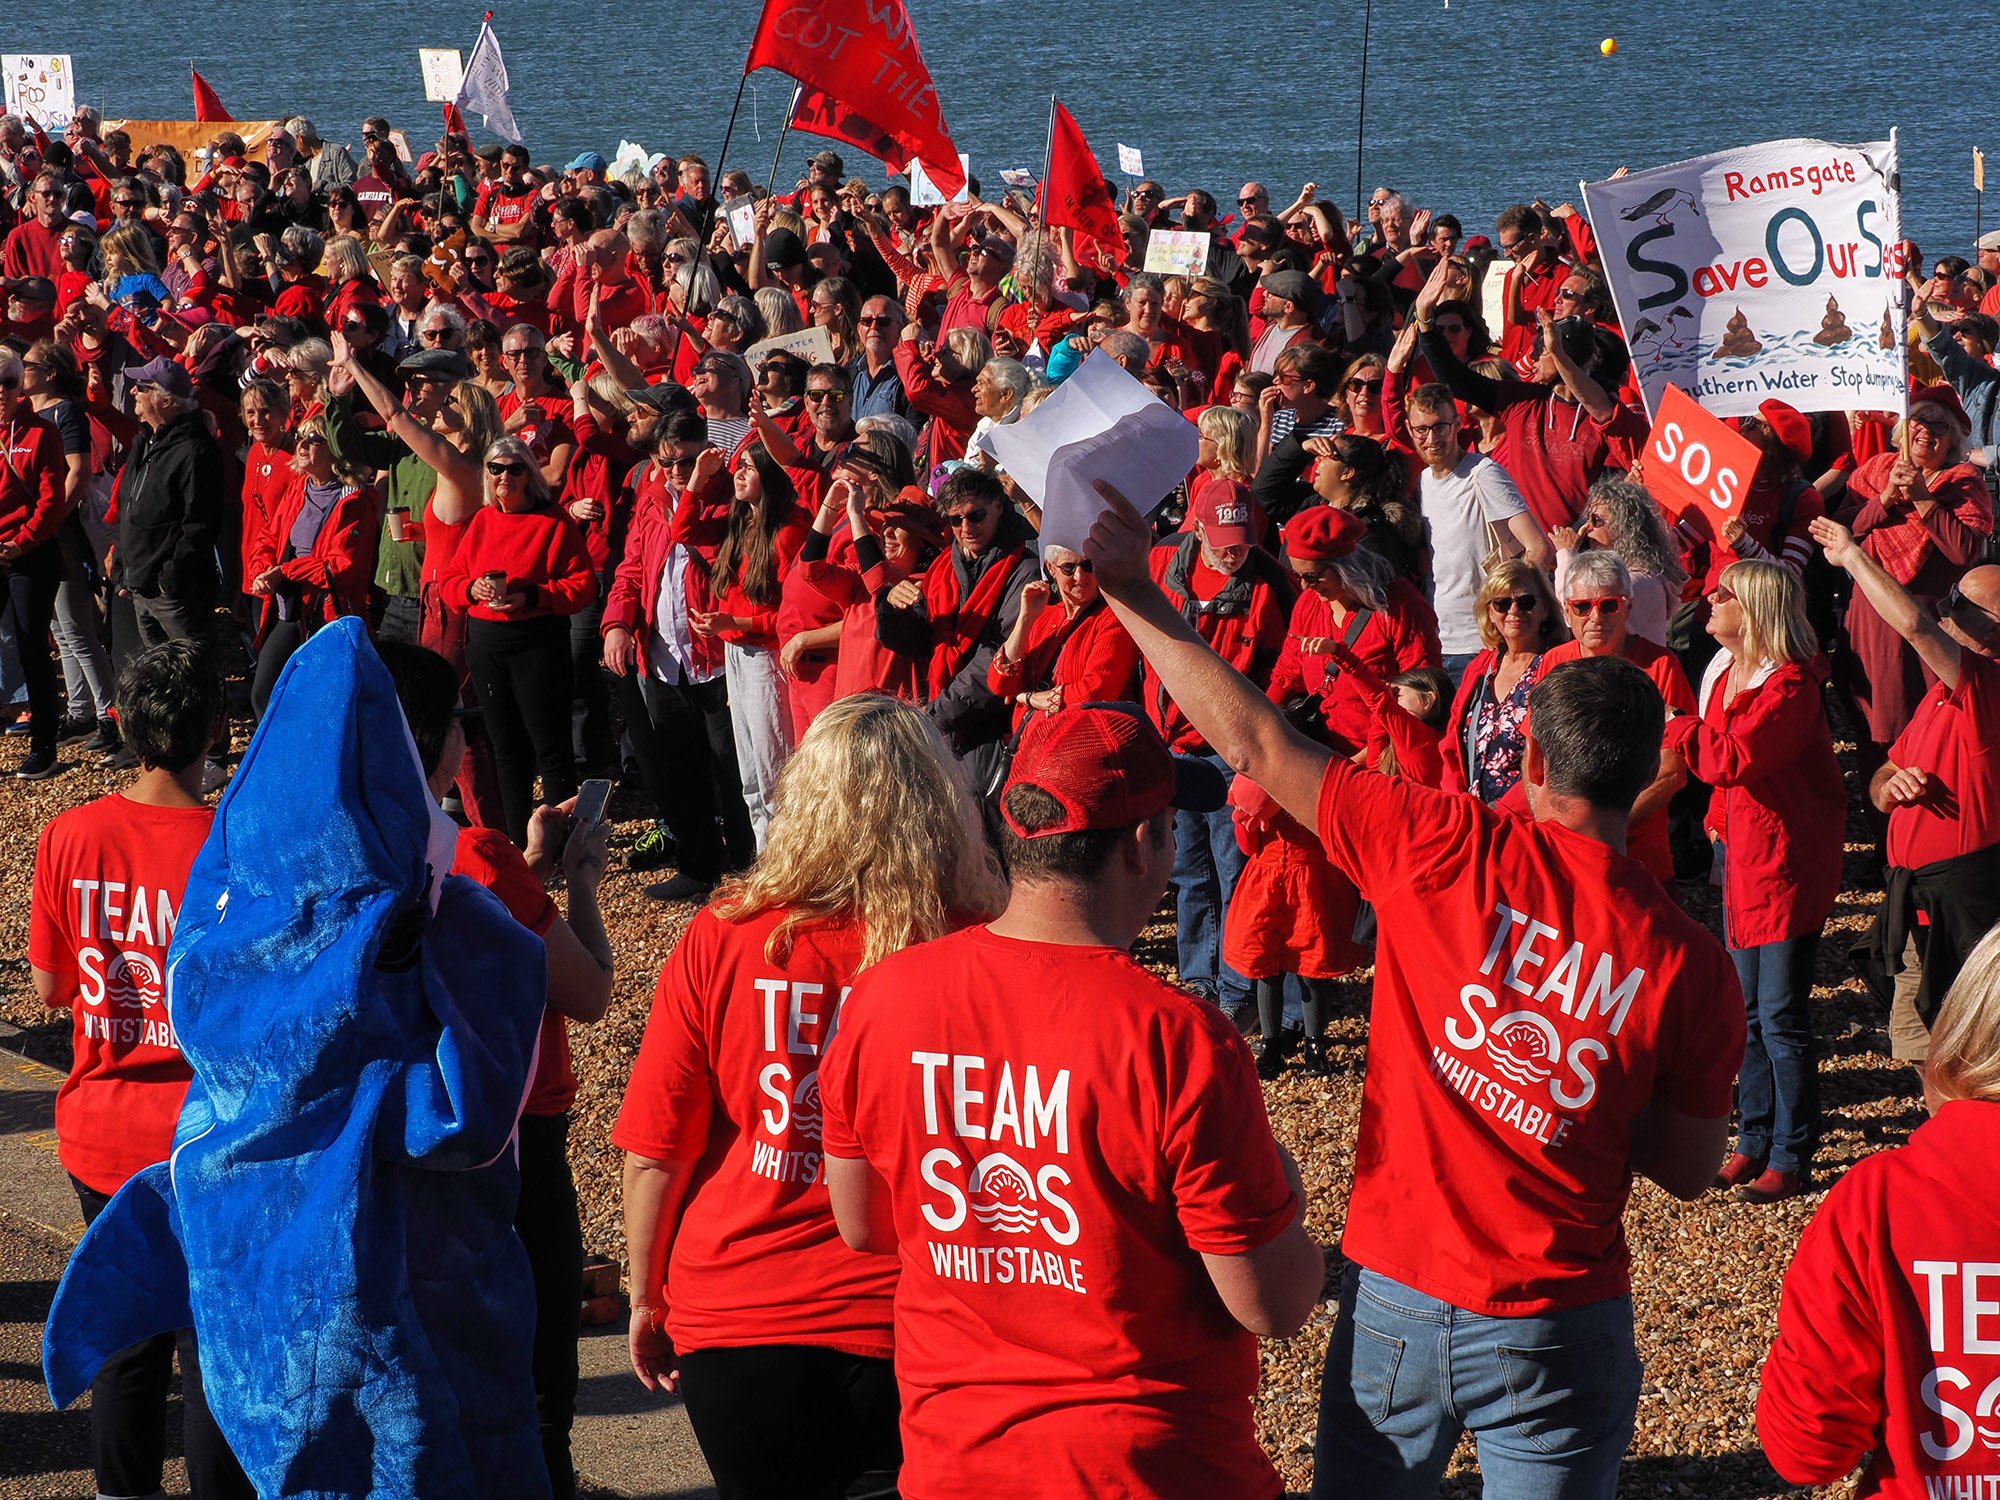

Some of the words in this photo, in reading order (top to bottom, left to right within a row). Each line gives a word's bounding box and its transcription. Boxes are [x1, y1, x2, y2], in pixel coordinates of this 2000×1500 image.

[18, 82, 46, 114] POO
[774, 7, 864, 60] CUT
[871, 51, 935, 119] THE
[1724, 158, 1857, 202] Ramsgate
[1626, 223, 1769, 312] Save
[1765, 207, 1859, 286] Our
[782, 337, 815, 351] WATER
[1758, 368, 1819, 391] Water
[1831, 365, 1863, 395] Stop
[1655, 422, 1739, 510] SOS
[1478, 902, 1646, 1037] TEAM
[1444, 983, 1609, 1109] SOS
[911, 1050, 1070, 1155] TEAM
[1429, 1045, 1574, 1148] WHITSTABLE
[920, 1147, 1081, 1246] SOS
[927, 1240, 1087, 1295] WHITSTABLE
